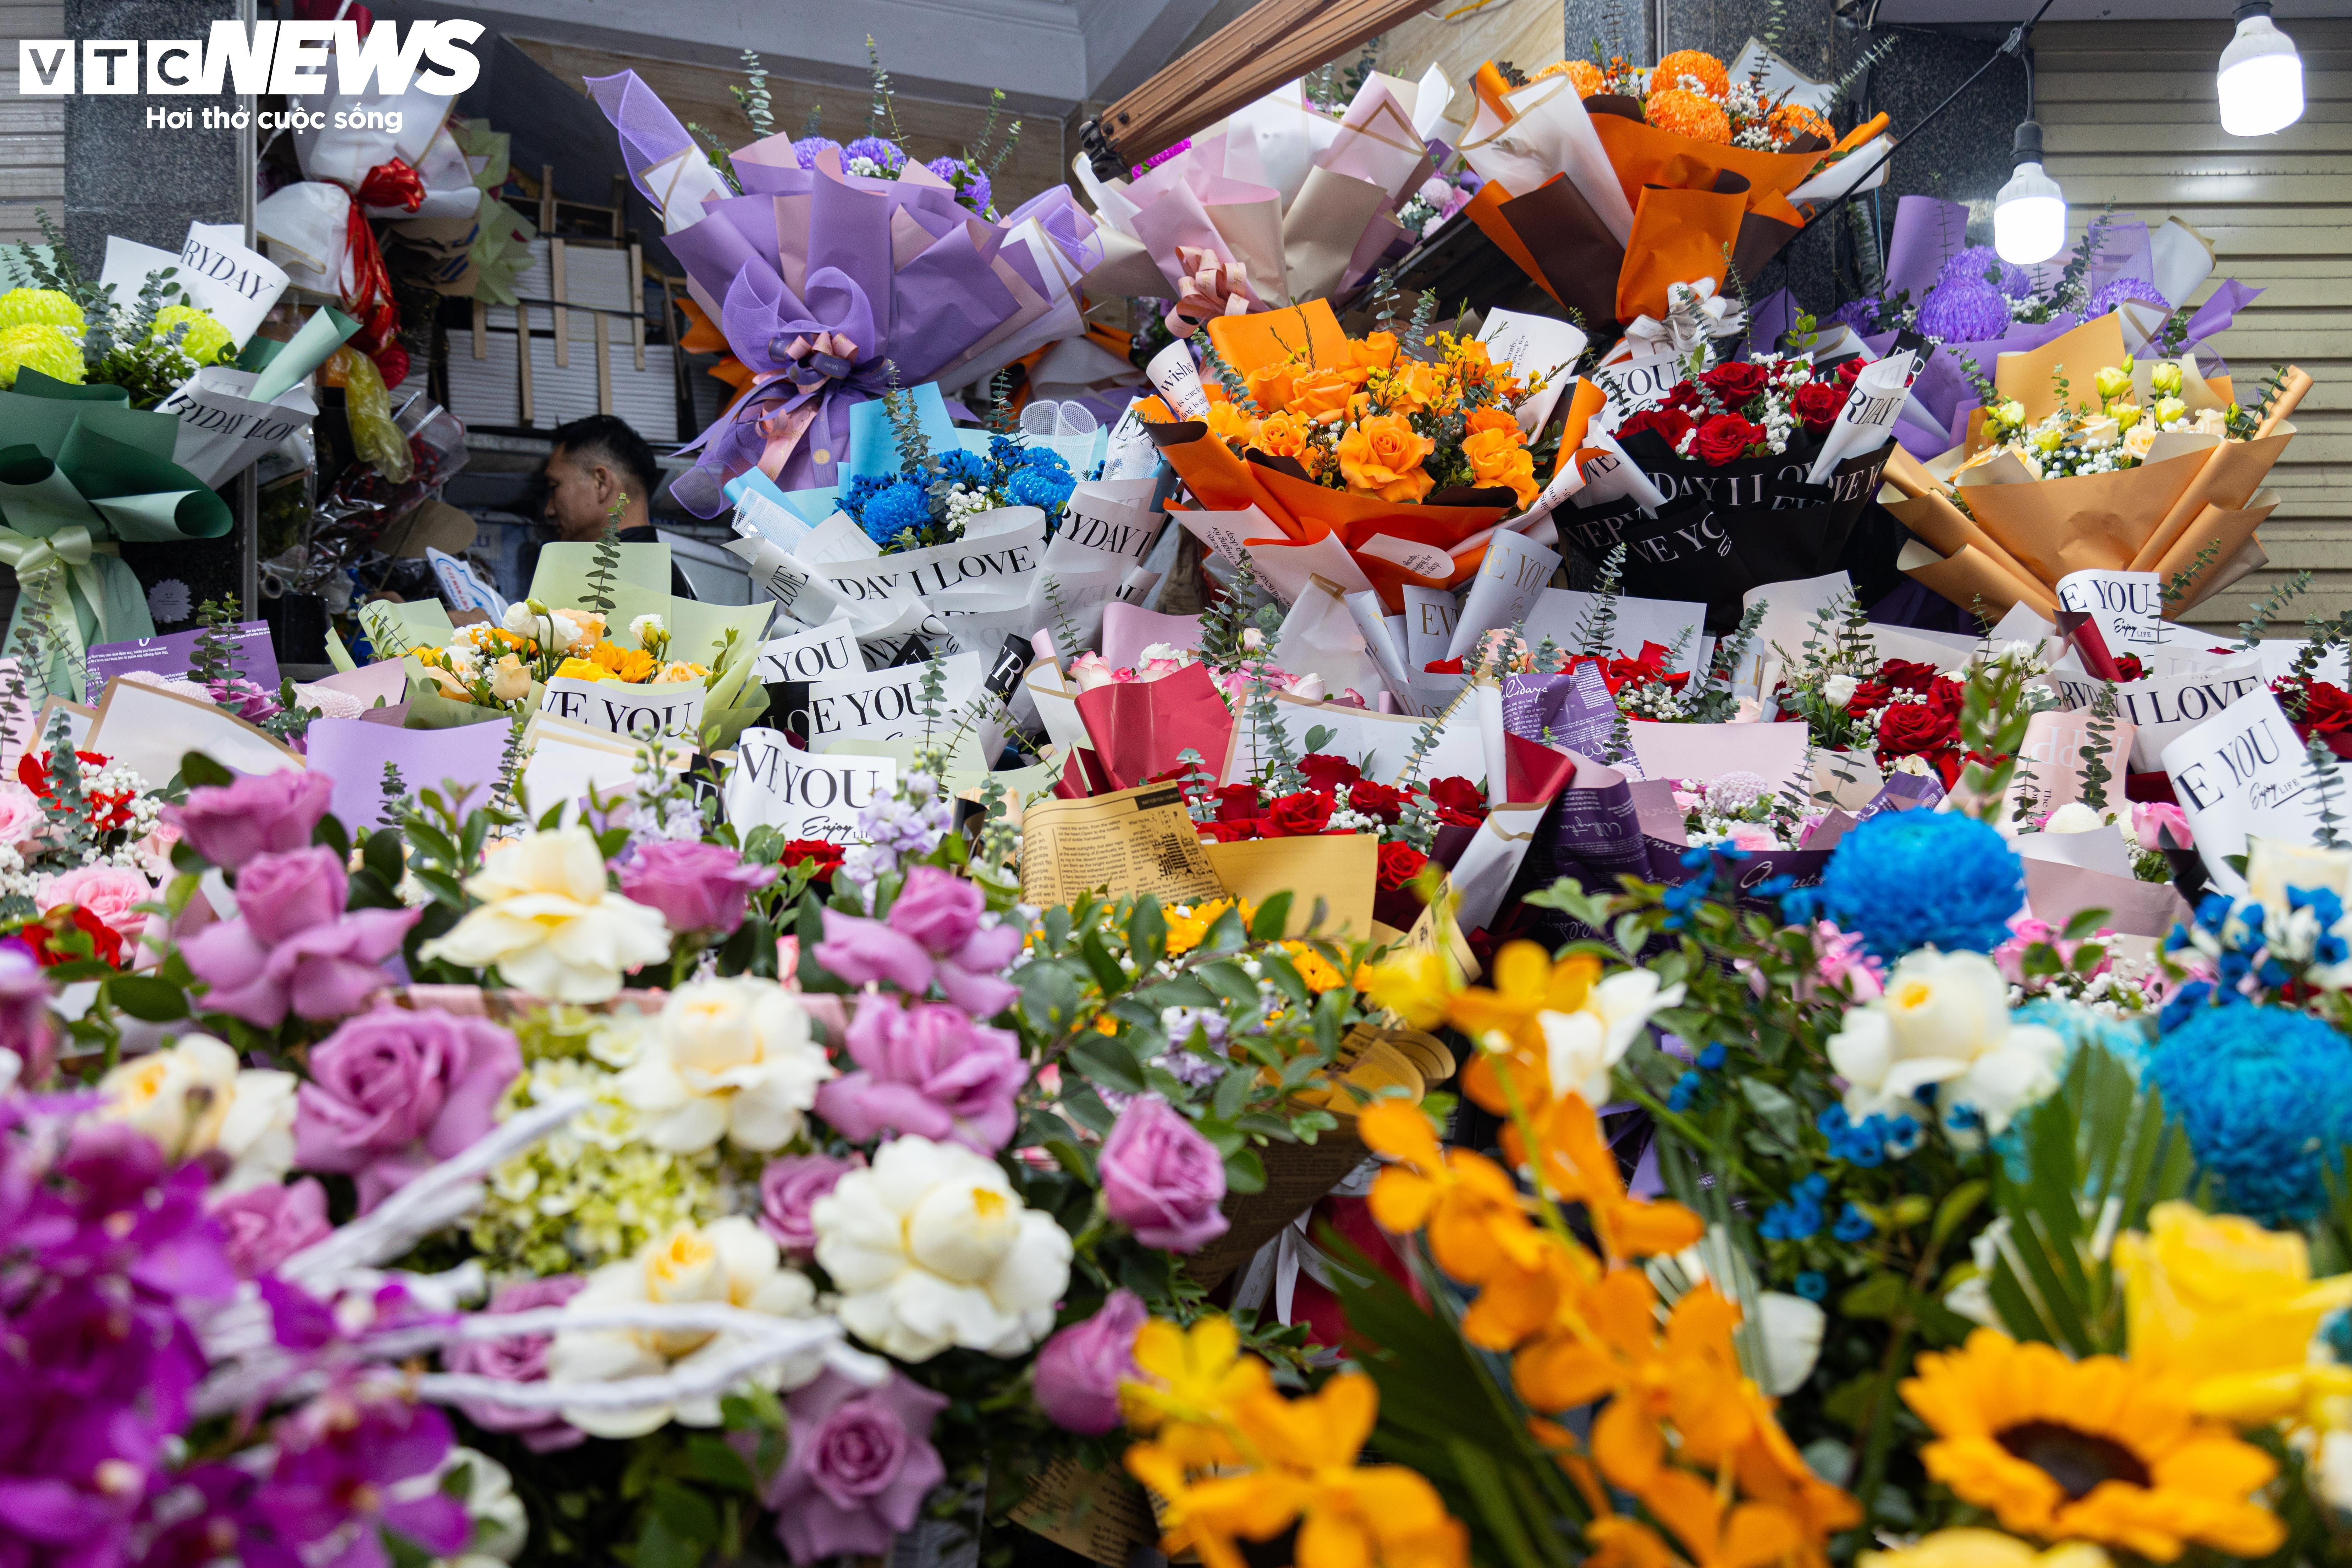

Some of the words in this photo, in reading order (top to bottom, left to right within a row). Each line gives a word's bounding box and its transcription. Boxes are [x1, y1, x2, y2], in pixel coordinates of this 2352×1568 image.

[1212, 527, 1221, 535] for
[1225, 530, 1238, 546] deep
[765, 565, 809, 607] LOVE
[908, 569, 929, 596] I
[930, 545, 1036, 590] LOVE
[1427, 562, 1441, 571] deep
[1483, 545, 1510, 580] E
[1514, 554, 1551, 596] YOU
[2058, 583, 2087, 612] E
[2089, 579, 2150, 615] YOU
[2113, 618, 2137, 638] Enjoy
[765, 636, 848, 682] YOU
[601, 699, 693, 742] YOU
[809, 697, 841, 734] E
[842, 681, 930, 727] YOU
[2124, 694, 2143, 726] I
[2147, 676, 2258, 724] LOVE
[783, 759, 880, 808] YOU
[2172, 762, 2224, 814] E
[2214, 718, 2280, 787] YOU
[2249, 782, 2277, 810] Enjoy
[2279, 779, 2299, 795] LIFE
[802, 816, 854, 840] Enjoy
